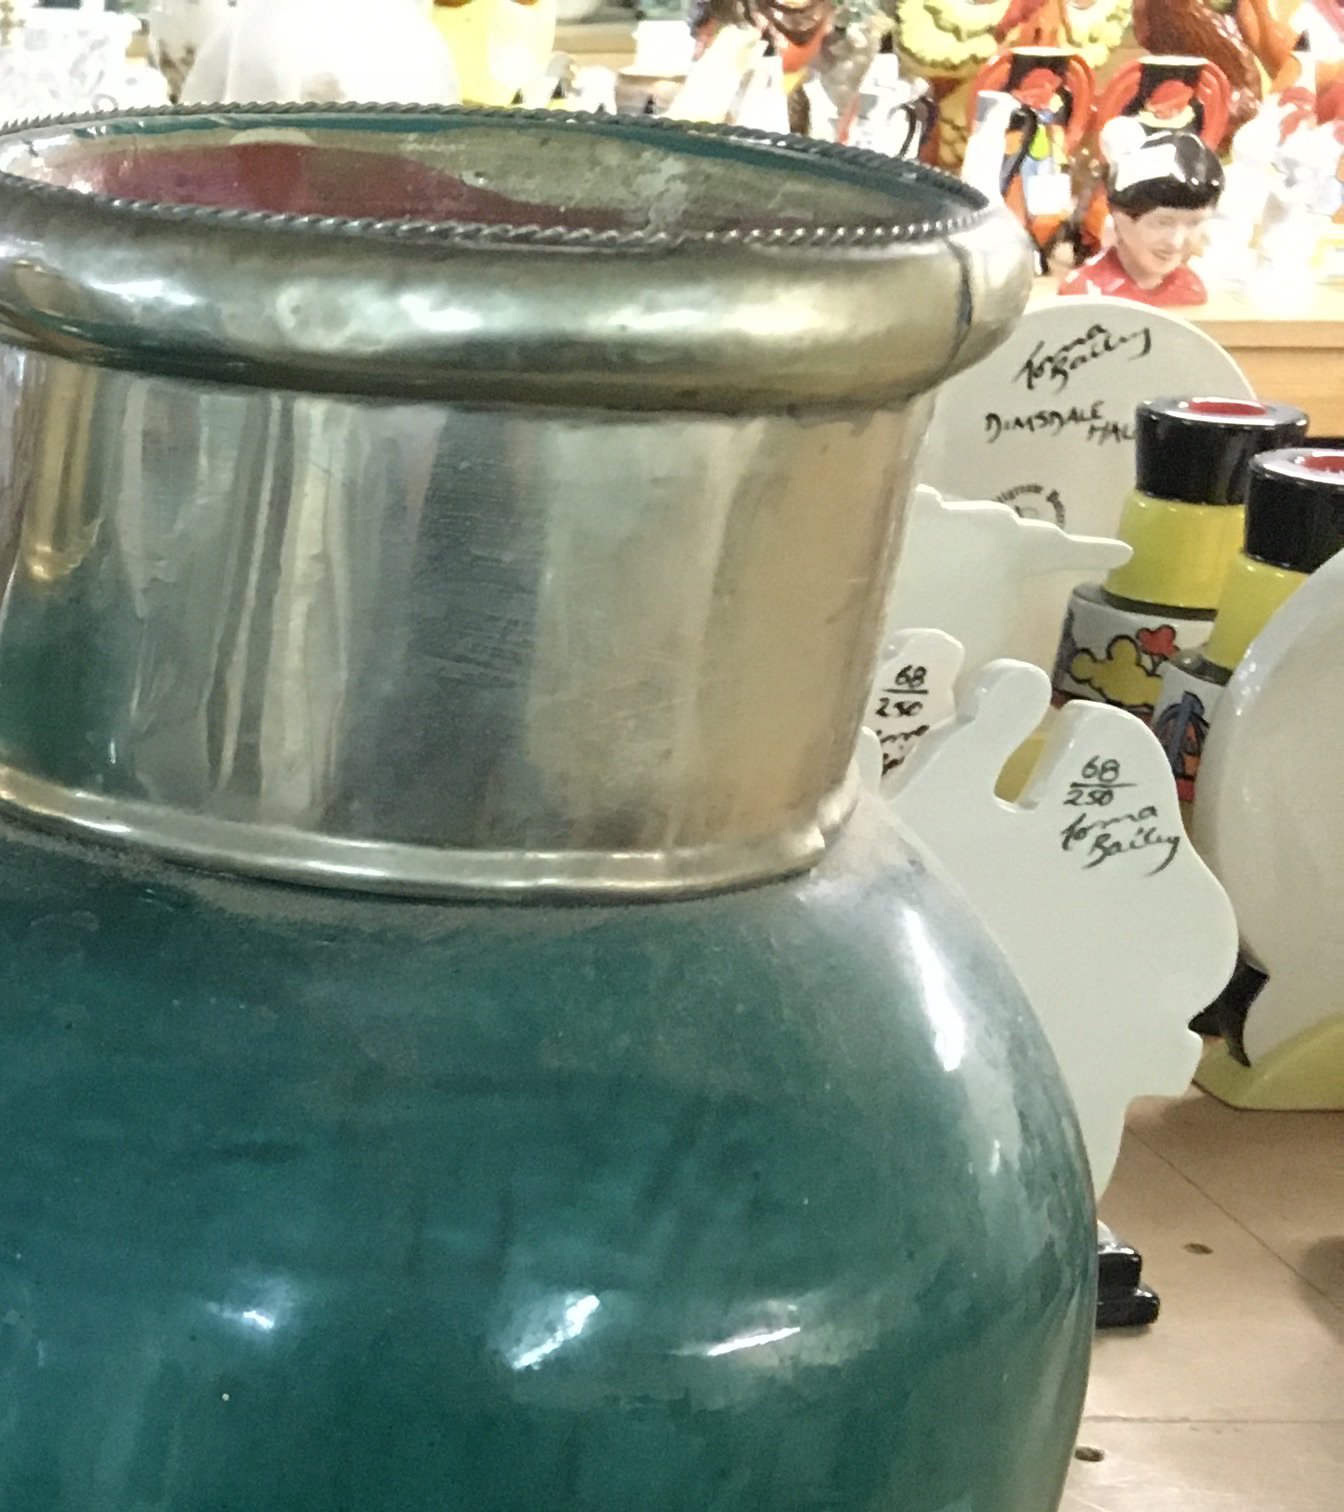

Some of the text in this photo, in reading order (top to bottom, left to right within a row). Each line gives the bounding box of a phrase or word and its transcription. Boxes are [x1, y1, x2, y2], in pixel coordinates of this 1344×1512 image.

[1085, 421, 1136, 446] HAL
[895, 664, 928, 688] 68
[875, 697, 923, 719] 250
[1081, 755, 1120, 783] 68
[1062, 788, 1115, 808] 250
[1083, 826, 1180, 878] Bailey
